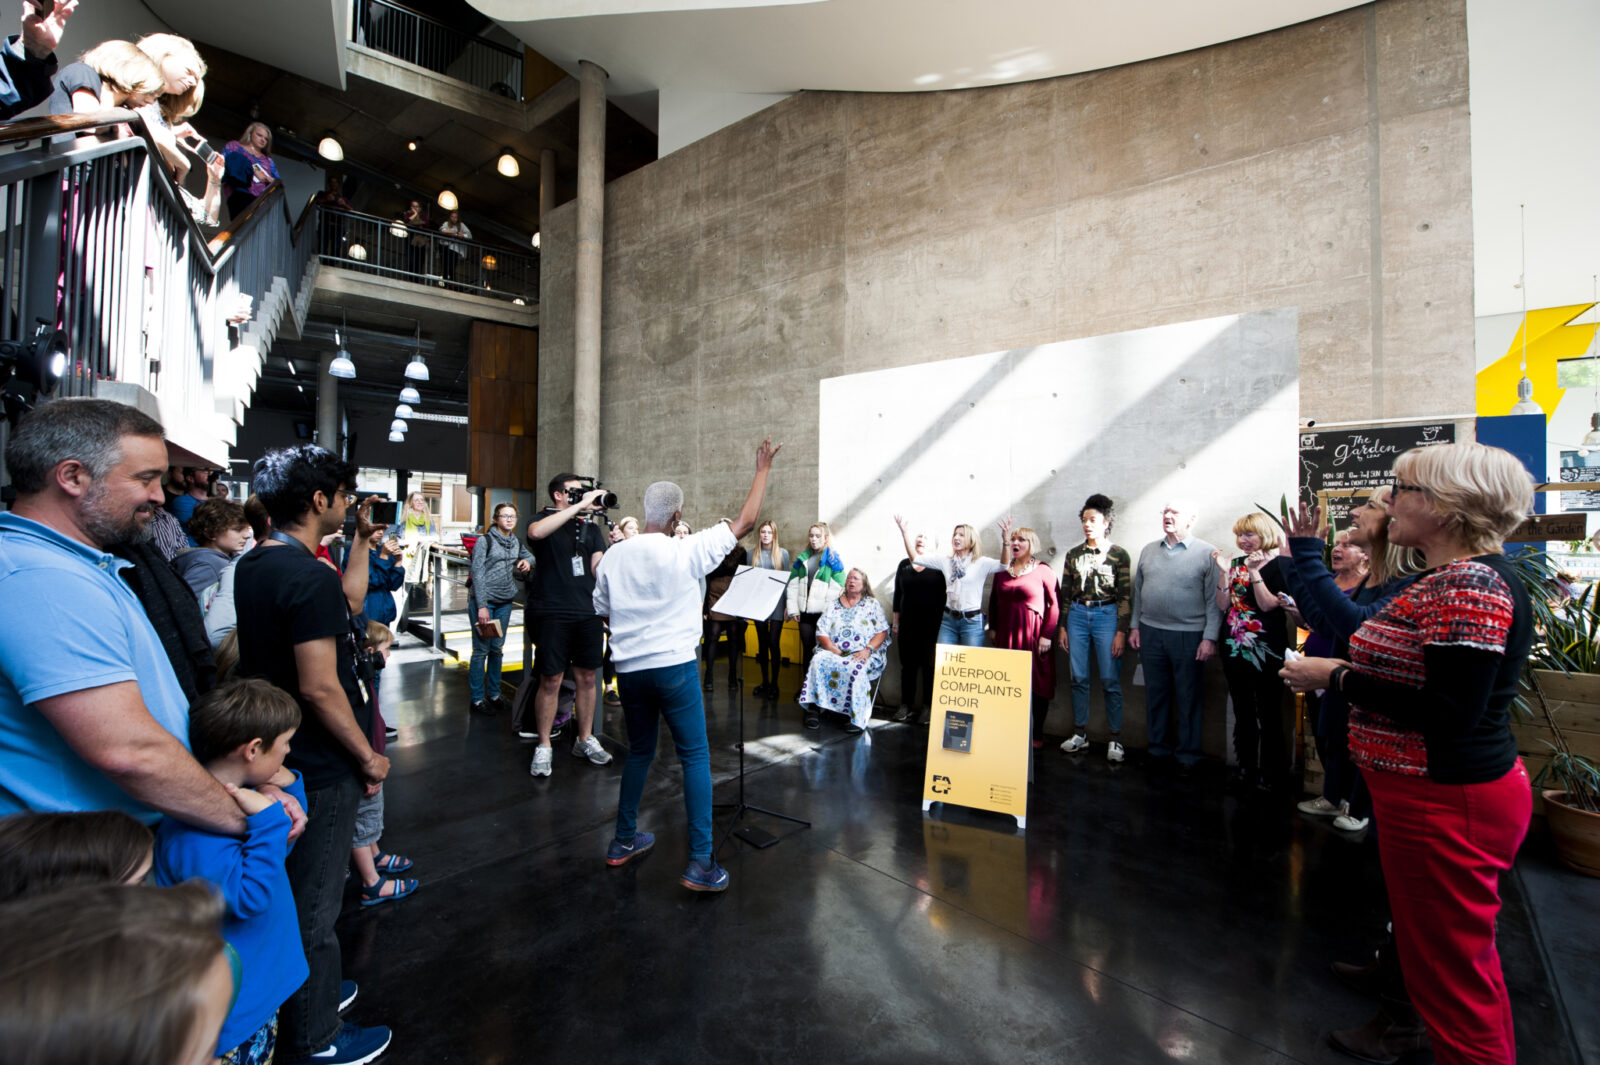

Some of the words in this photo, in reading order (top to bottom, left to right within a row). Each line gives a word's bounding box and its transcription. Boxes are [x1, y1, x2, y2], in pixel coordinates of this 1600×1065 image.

[1348, 435, 1371, 448] The
[1528, 524, 1543, 536] the
[1546, 520, 1584, 536] Garden
[944, 652, 966, 663] THE
[941, 666, 1011, 682] LIVERPOOL
[940, 680, 1022, 698] COMPLAINTS
[939, 694, 979, 709] CHOIR
